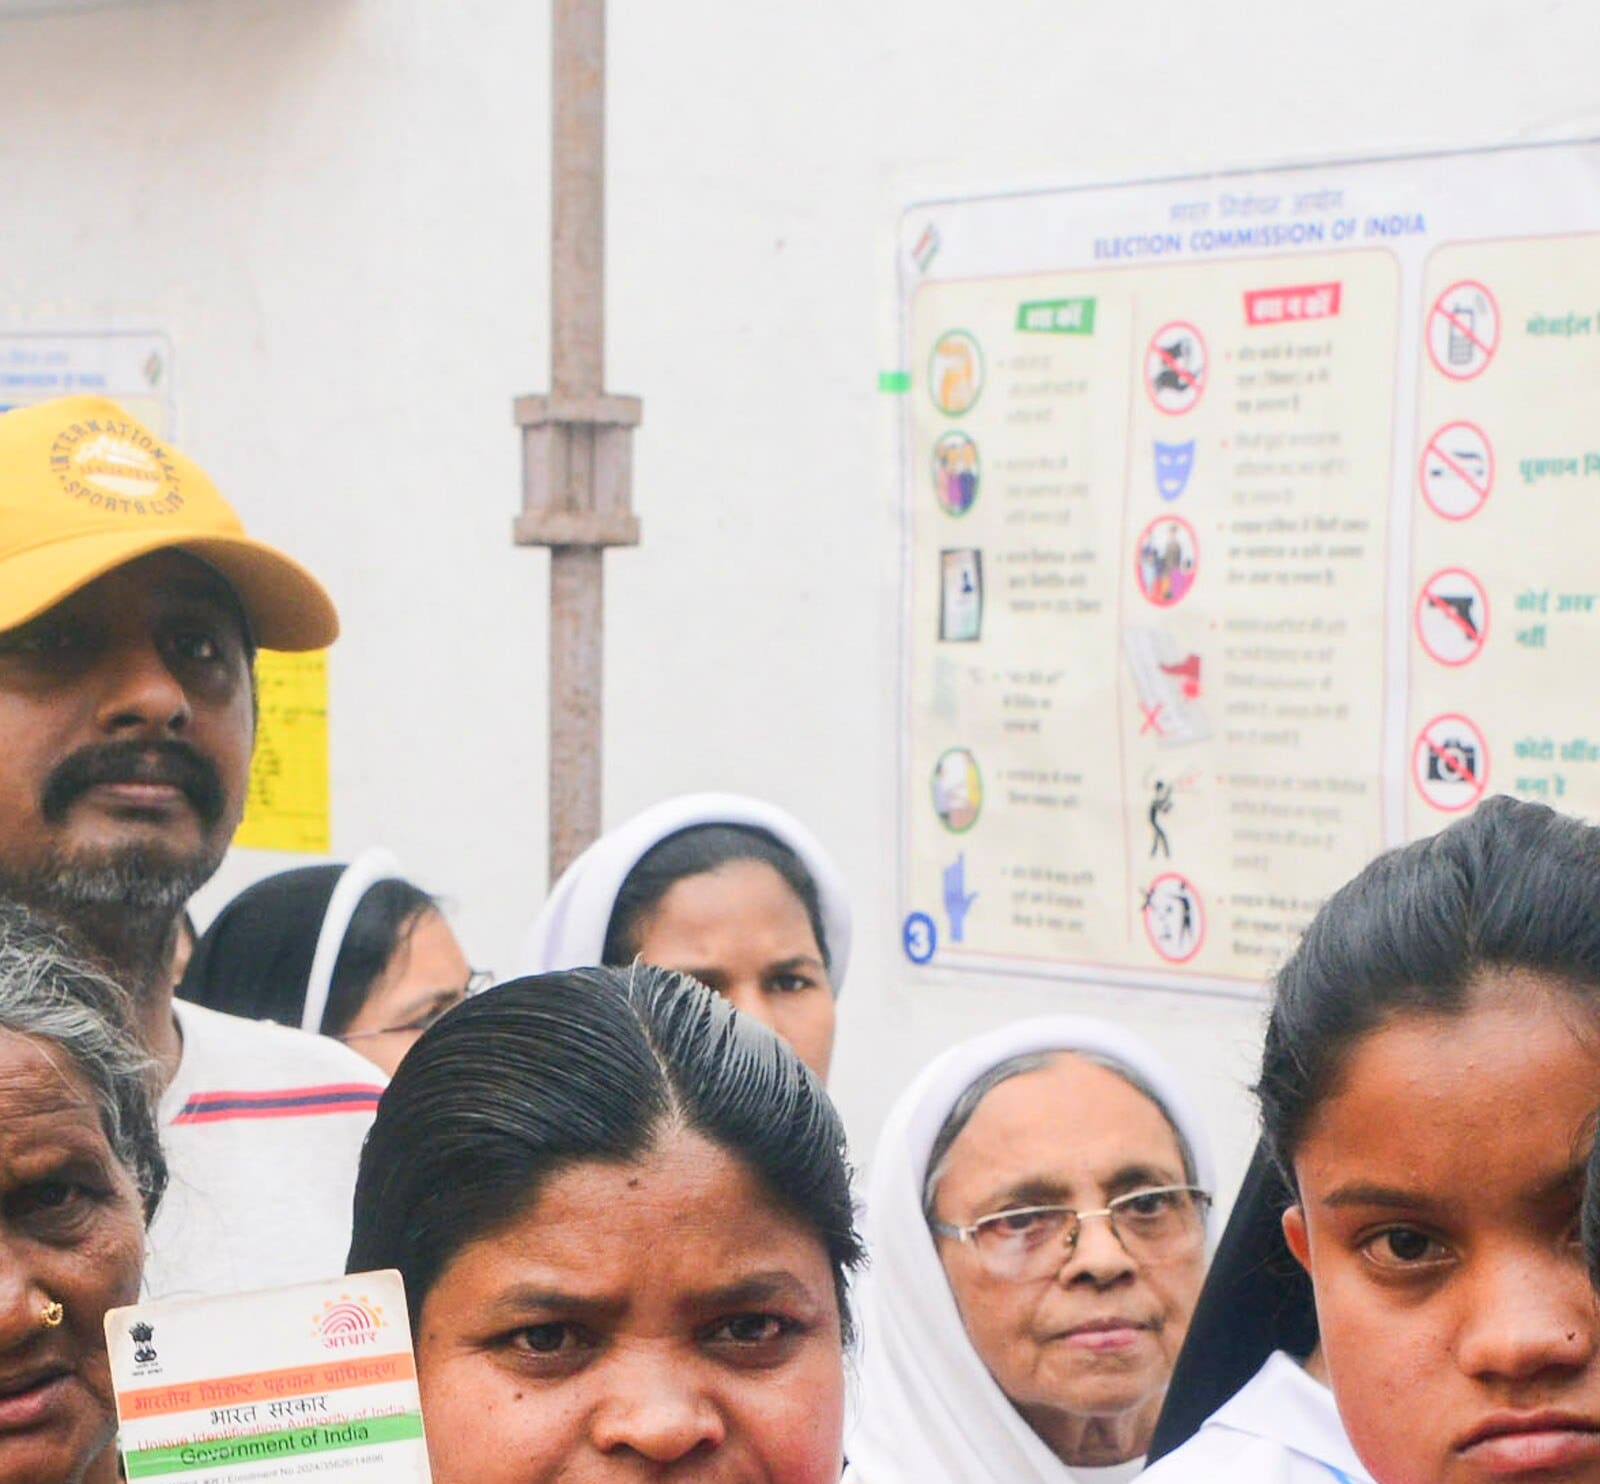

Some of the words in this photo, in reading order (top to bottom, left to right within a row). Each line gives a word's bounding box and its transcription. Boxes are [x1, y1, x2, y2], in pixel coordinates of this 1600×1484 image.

[1093, 233, 1182, 260] ELECTION
[1189, 221, 1325, 252] COMMISSION
[1331, 216, 1358, 241] OF
[1363, 211, 1428, 239] INDIA
[48, 417, 182, 475] INTERNATIONAL
[62, 479, 148, 516] SPORTS
[323, 1330, 379, 1350] आधार
[133, 1388, 192, 1412] भारतीय
[263, 1372, 316, 1397] पहचान
[209, 1403, 258, 1427] भारत
[267, 1395, 329, 1420] सरकार
[137, 1431, 189, 1455] Unique
[192, 1420, 284, 1447] Identification
[287, 1411, 350, 1434] Authority
[354, 1407, 369, 1420] of
[371, 1400, 408, 1418] India
[179, 1434, 295, 1467] Government
[300, 1428, 319, 1449] of
[324, 1423, 370, 1446] India
